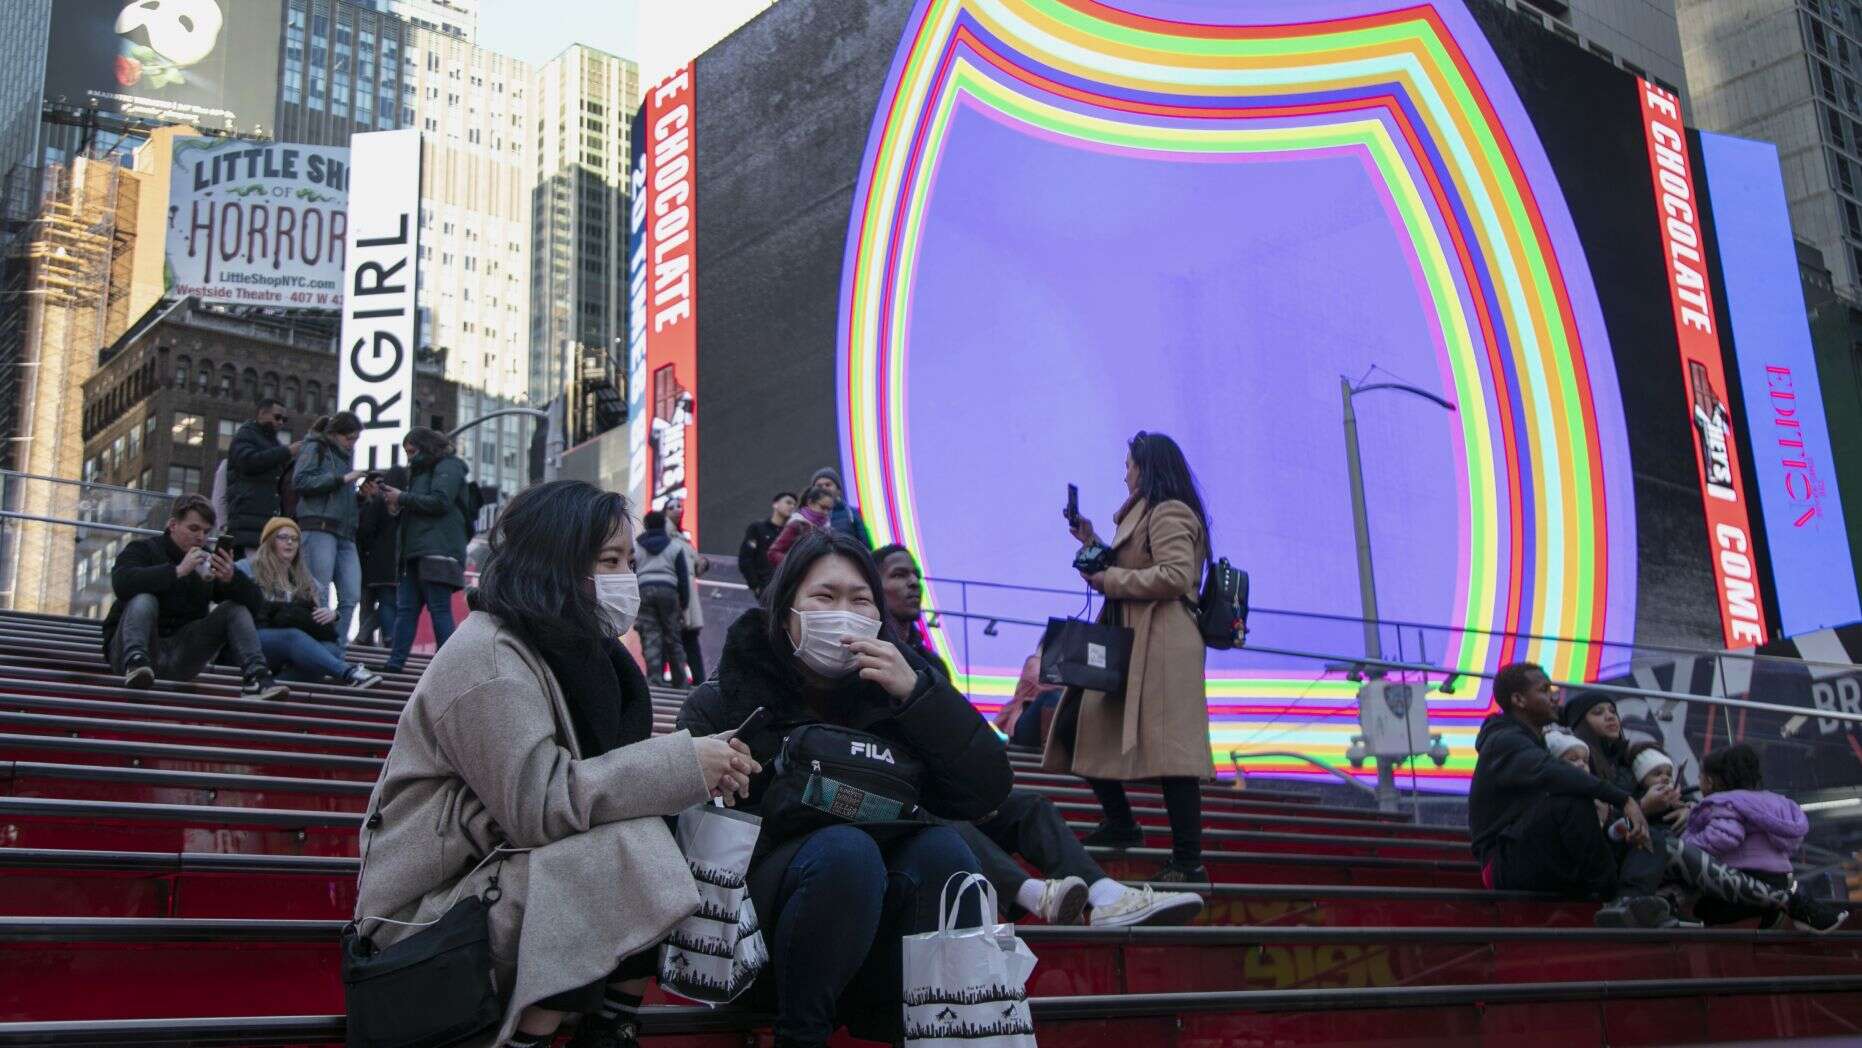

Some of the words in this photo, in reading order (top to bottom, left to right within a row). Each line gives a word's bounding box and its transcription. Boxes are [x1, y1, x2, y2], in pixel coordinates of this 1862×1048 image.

[655, 66, 689, 109] E
[1645, 78, 1677, 121] E
[194, 148, 299, 192] LITTLE
[272, 186, 294, 198] OF
[654, 104, 690, 333] CHOCOLATE
[1651, 119, 1712, 335] CHOCOLATE
[187, 200, 347, 284] HORROR
[176, 283, 233, 298] Westside
[236, 287, 282, 301] Theatre
[290, 291, 313, 303] 407
[316, 293, 329, 304] W
[219, 271, 336, 290] LittleShopNYC.com
[1716, 522, 1763, 647] COME
[850, 741, 895, 765] FILA
